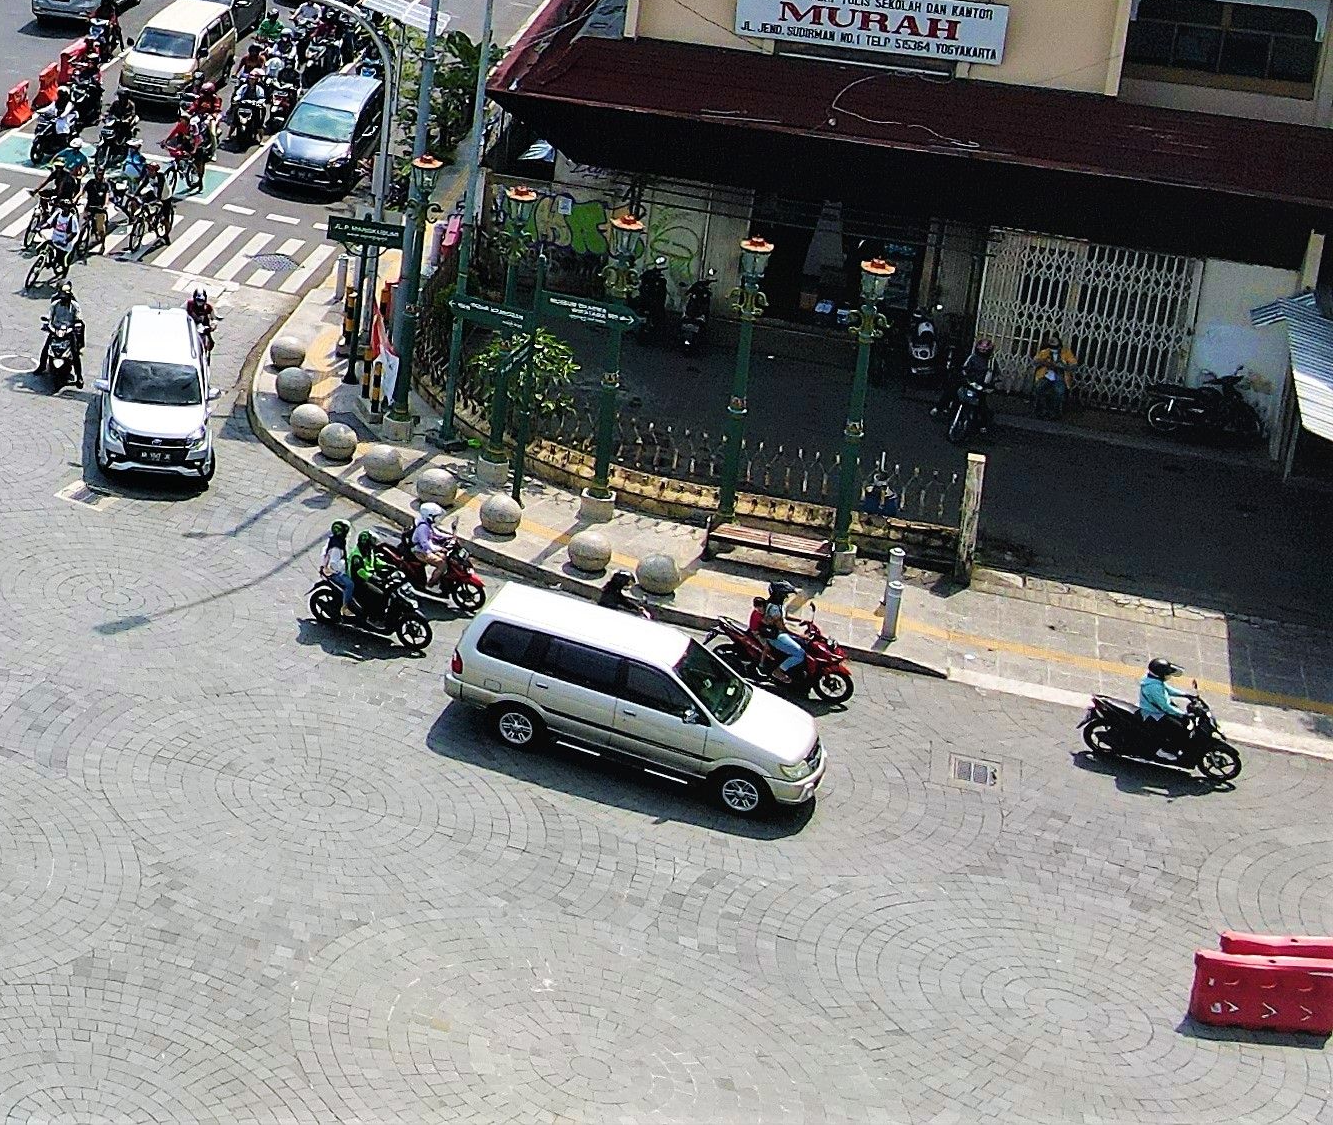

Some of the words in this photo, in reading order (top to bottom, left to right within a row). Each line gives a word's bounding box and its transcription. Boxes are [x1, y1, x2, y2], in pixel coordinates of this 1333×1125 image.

[779, 1, 962, 41] MURAH
[926, 2, 946, 15] DAN
[951, 5, 993, 20] KANTOR
[758, 22, 785, 36] JEND.
[787, 26, 834, 42] SUDIRMAN
[935, 43, 997, 60] YOGYAKARTA
